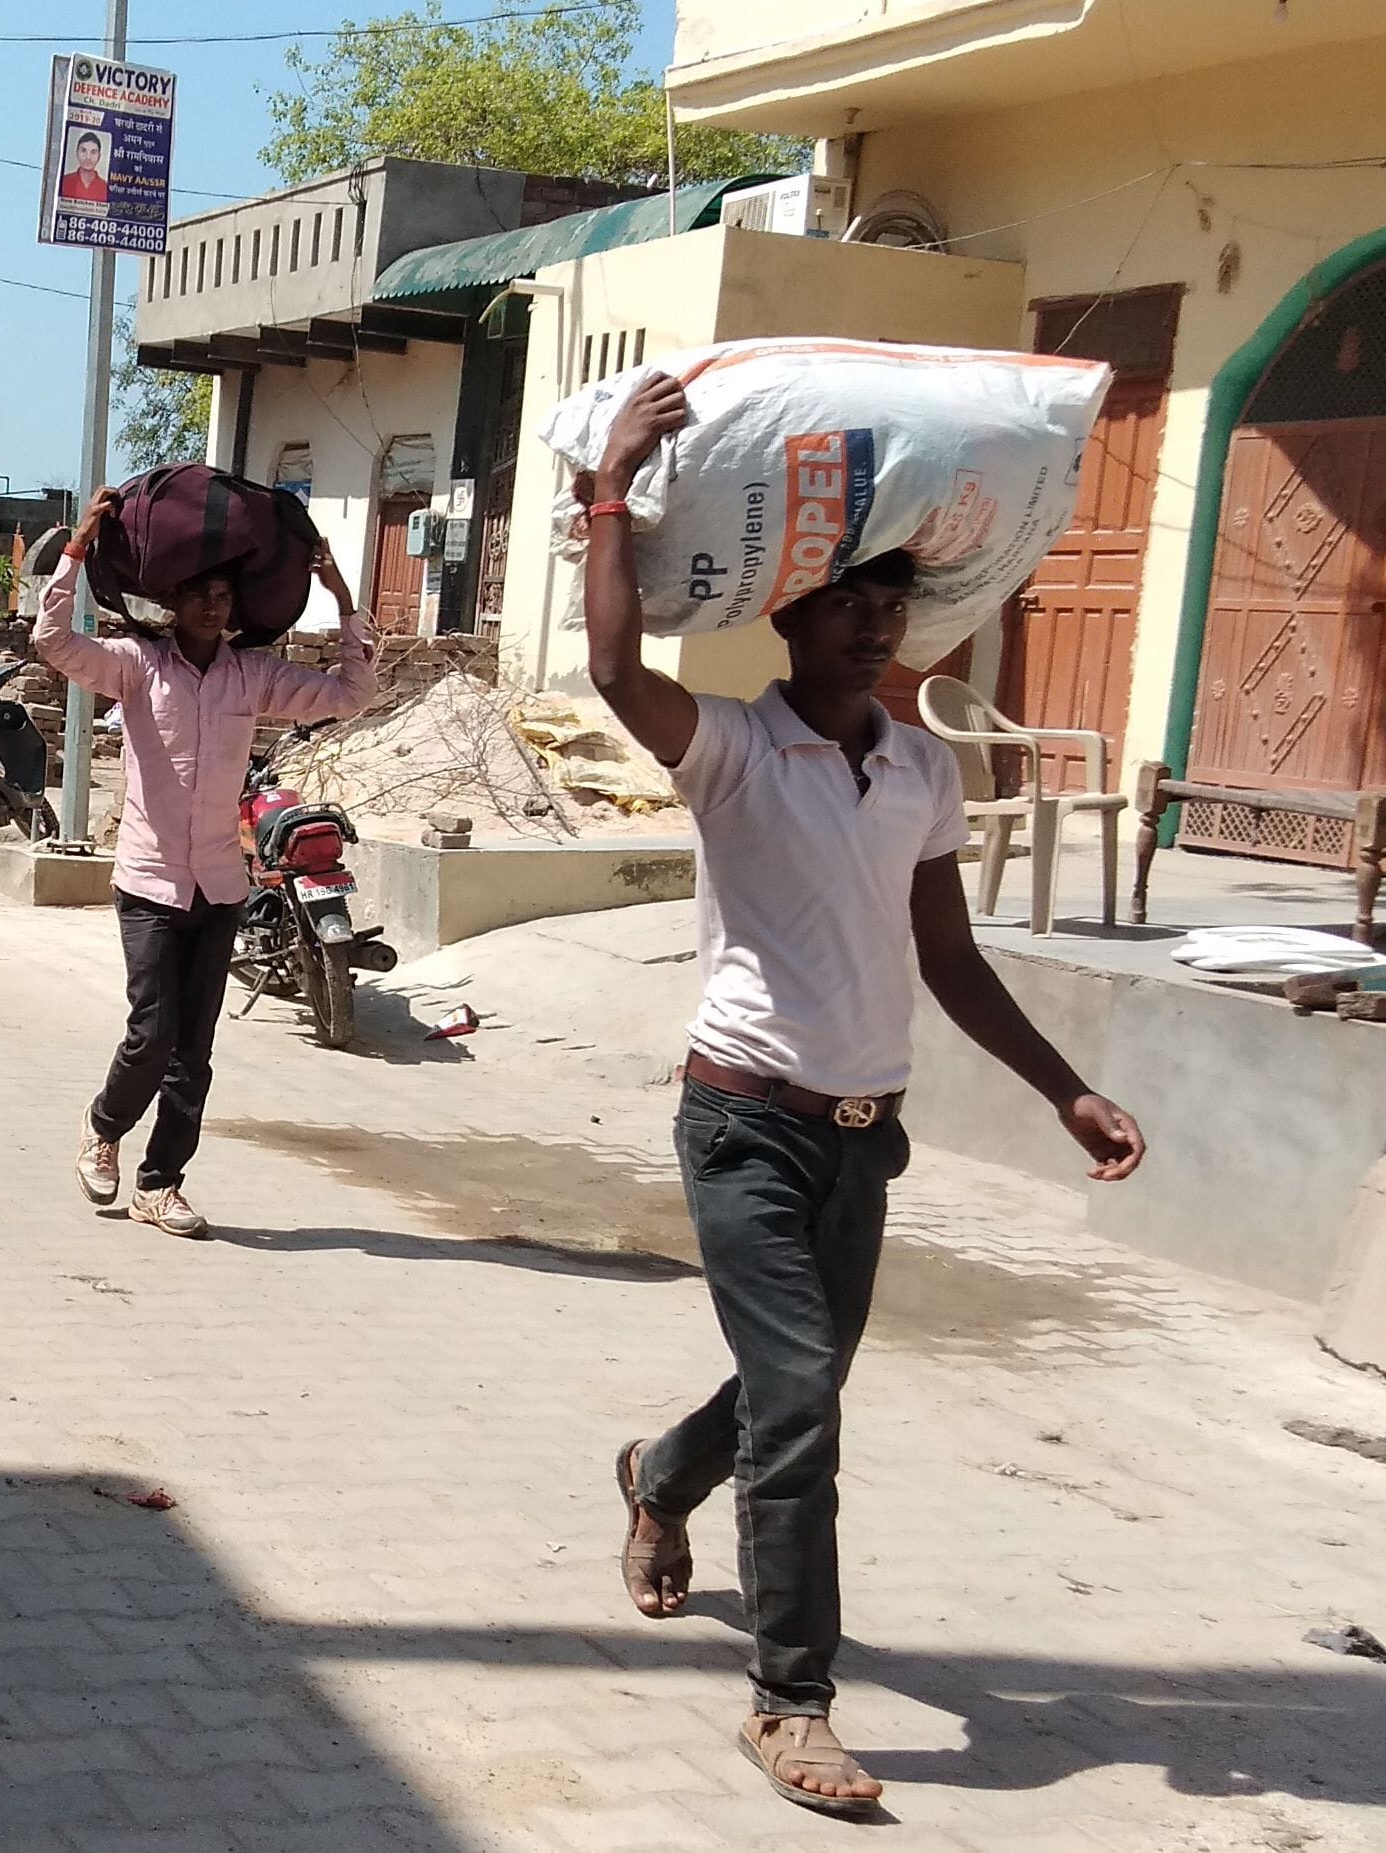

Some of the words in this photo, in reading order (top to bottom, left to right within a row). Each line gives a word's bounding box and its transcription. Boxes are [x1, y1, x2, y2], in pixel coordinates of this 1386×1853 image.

[96, 63, 171, 95] VICTORY
[74, 82, 118, 99] DEFENCE
[120, 90, 170, 109] ACADEMY
[99, 99, 121, 110] Dadri
[123, 134, 142, 145] अमन
[109, 172, 133, 183] NAVY
[68, 216, 164, 239] 86-408-44000
[67, 229, 163, 251] 86-409-44000
[1025, 466, 1048, 519] LIMITED
[689, 552, 728, 600] PP
[300, 890, 314, 900] HR
